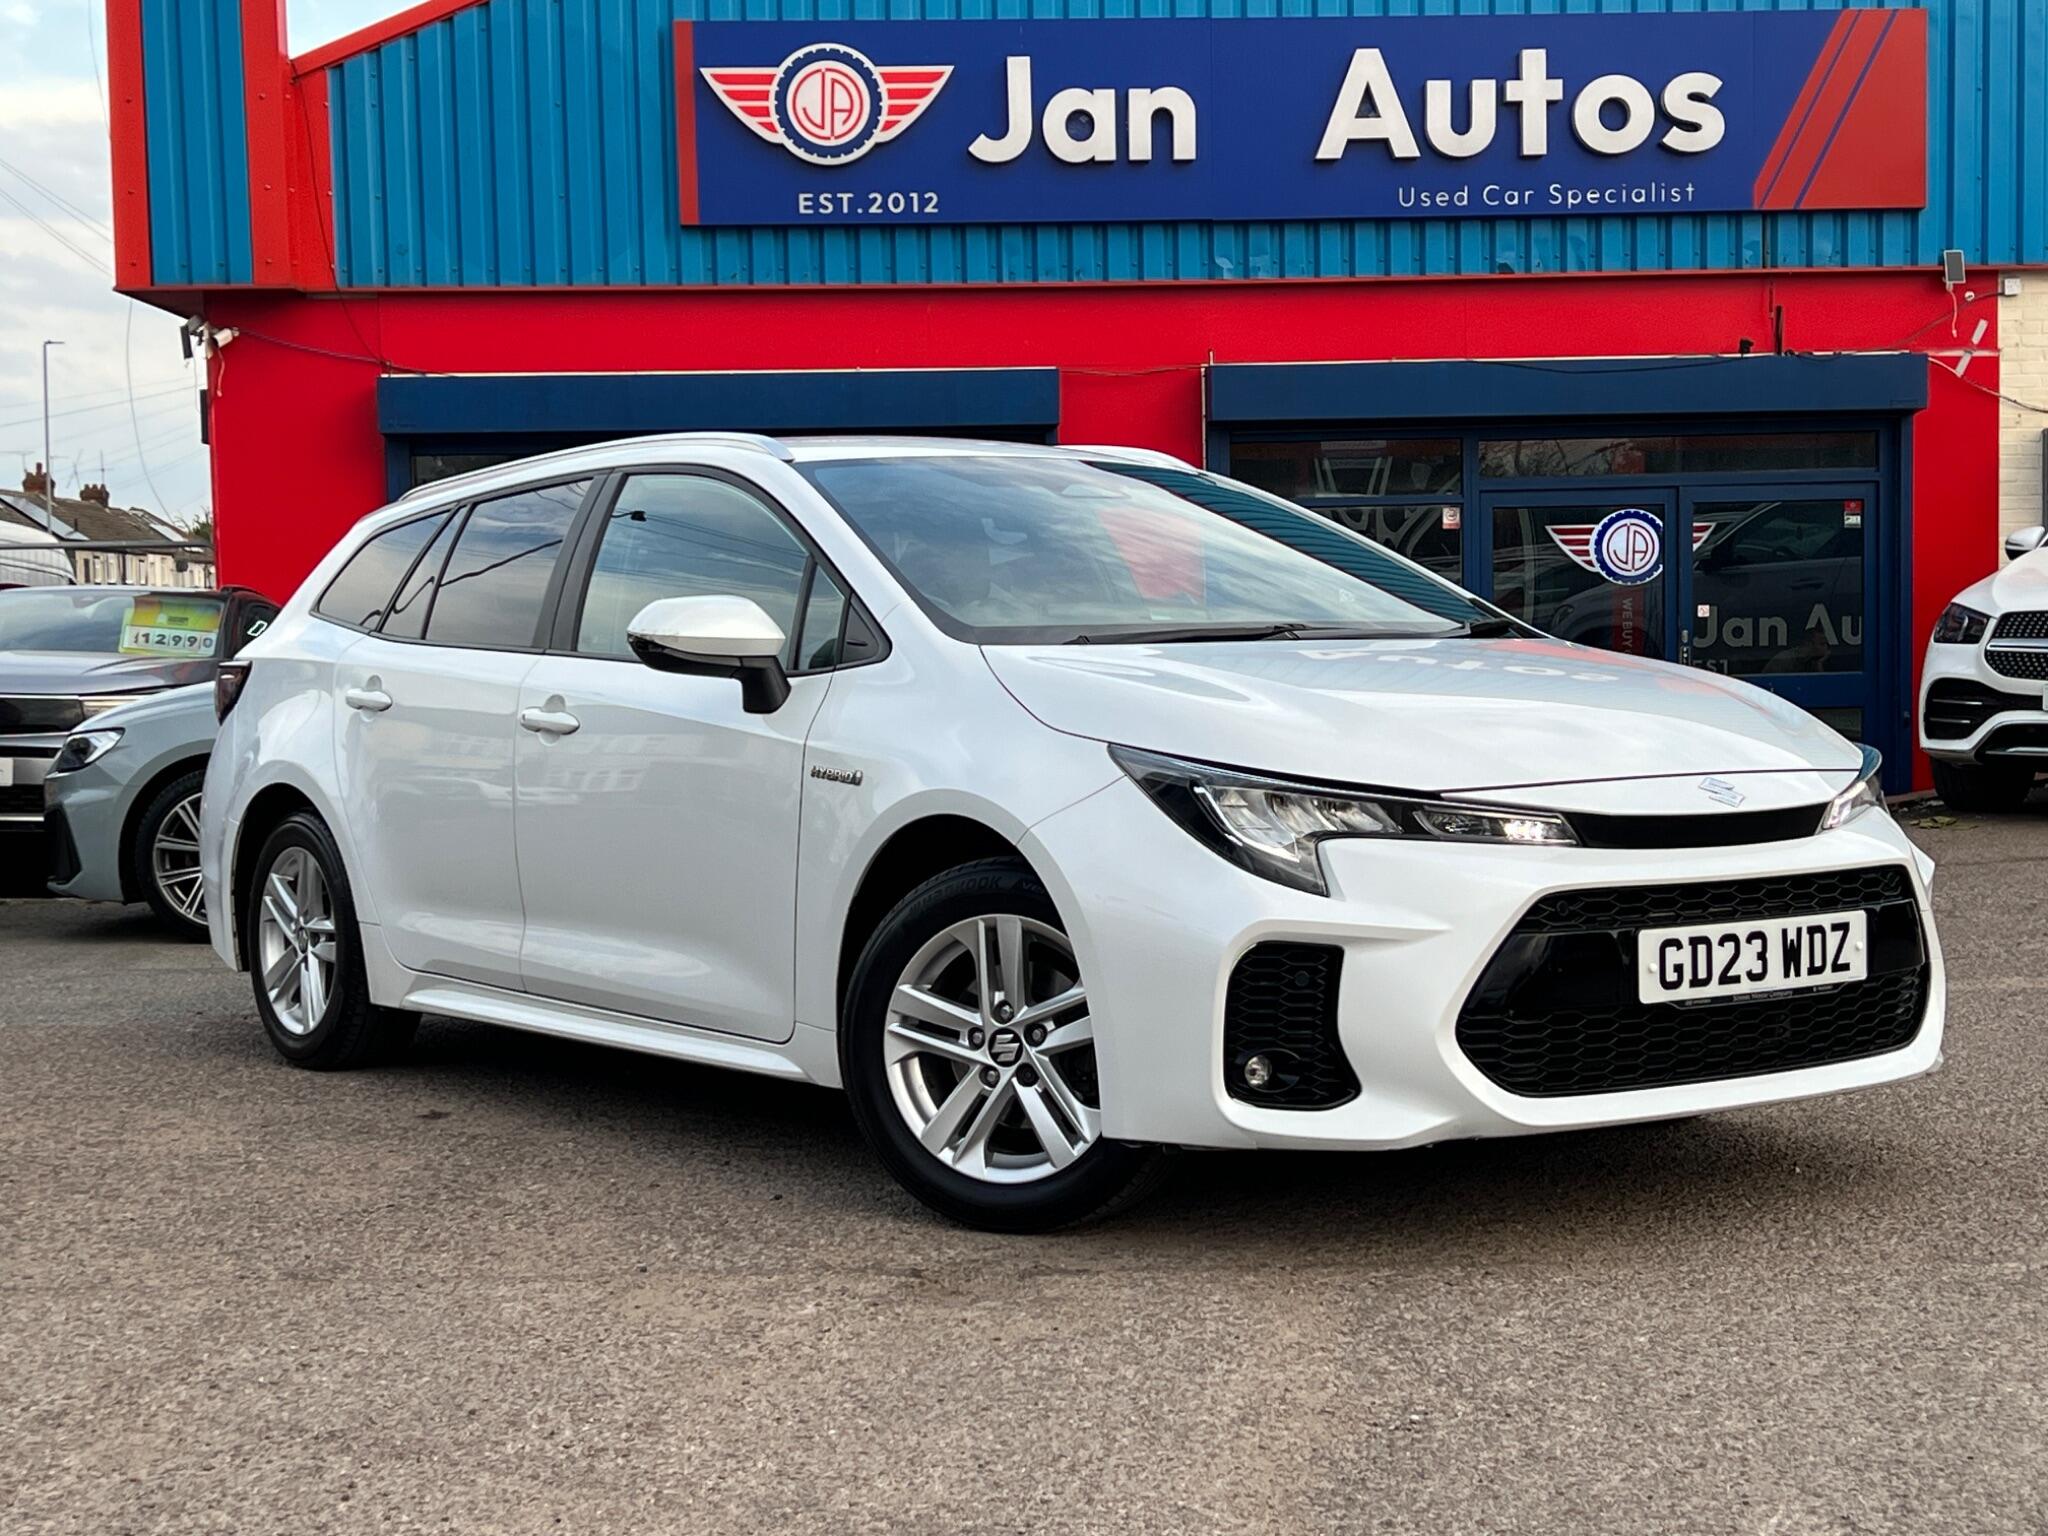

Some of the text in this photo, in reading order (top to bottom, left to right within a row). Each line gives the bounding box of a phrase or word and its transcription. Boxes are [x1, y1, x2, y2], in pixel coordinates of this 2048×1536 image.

[968, 47, 1726, 164] Jan Autos
[797, 191, 940, 216] EST.2012
[1398, 181, 1697, 209] Used Car Specialist
[1692, 604, 1788, 648] Jan
[1658, 921, 1851, 991] GD23 WDZ
